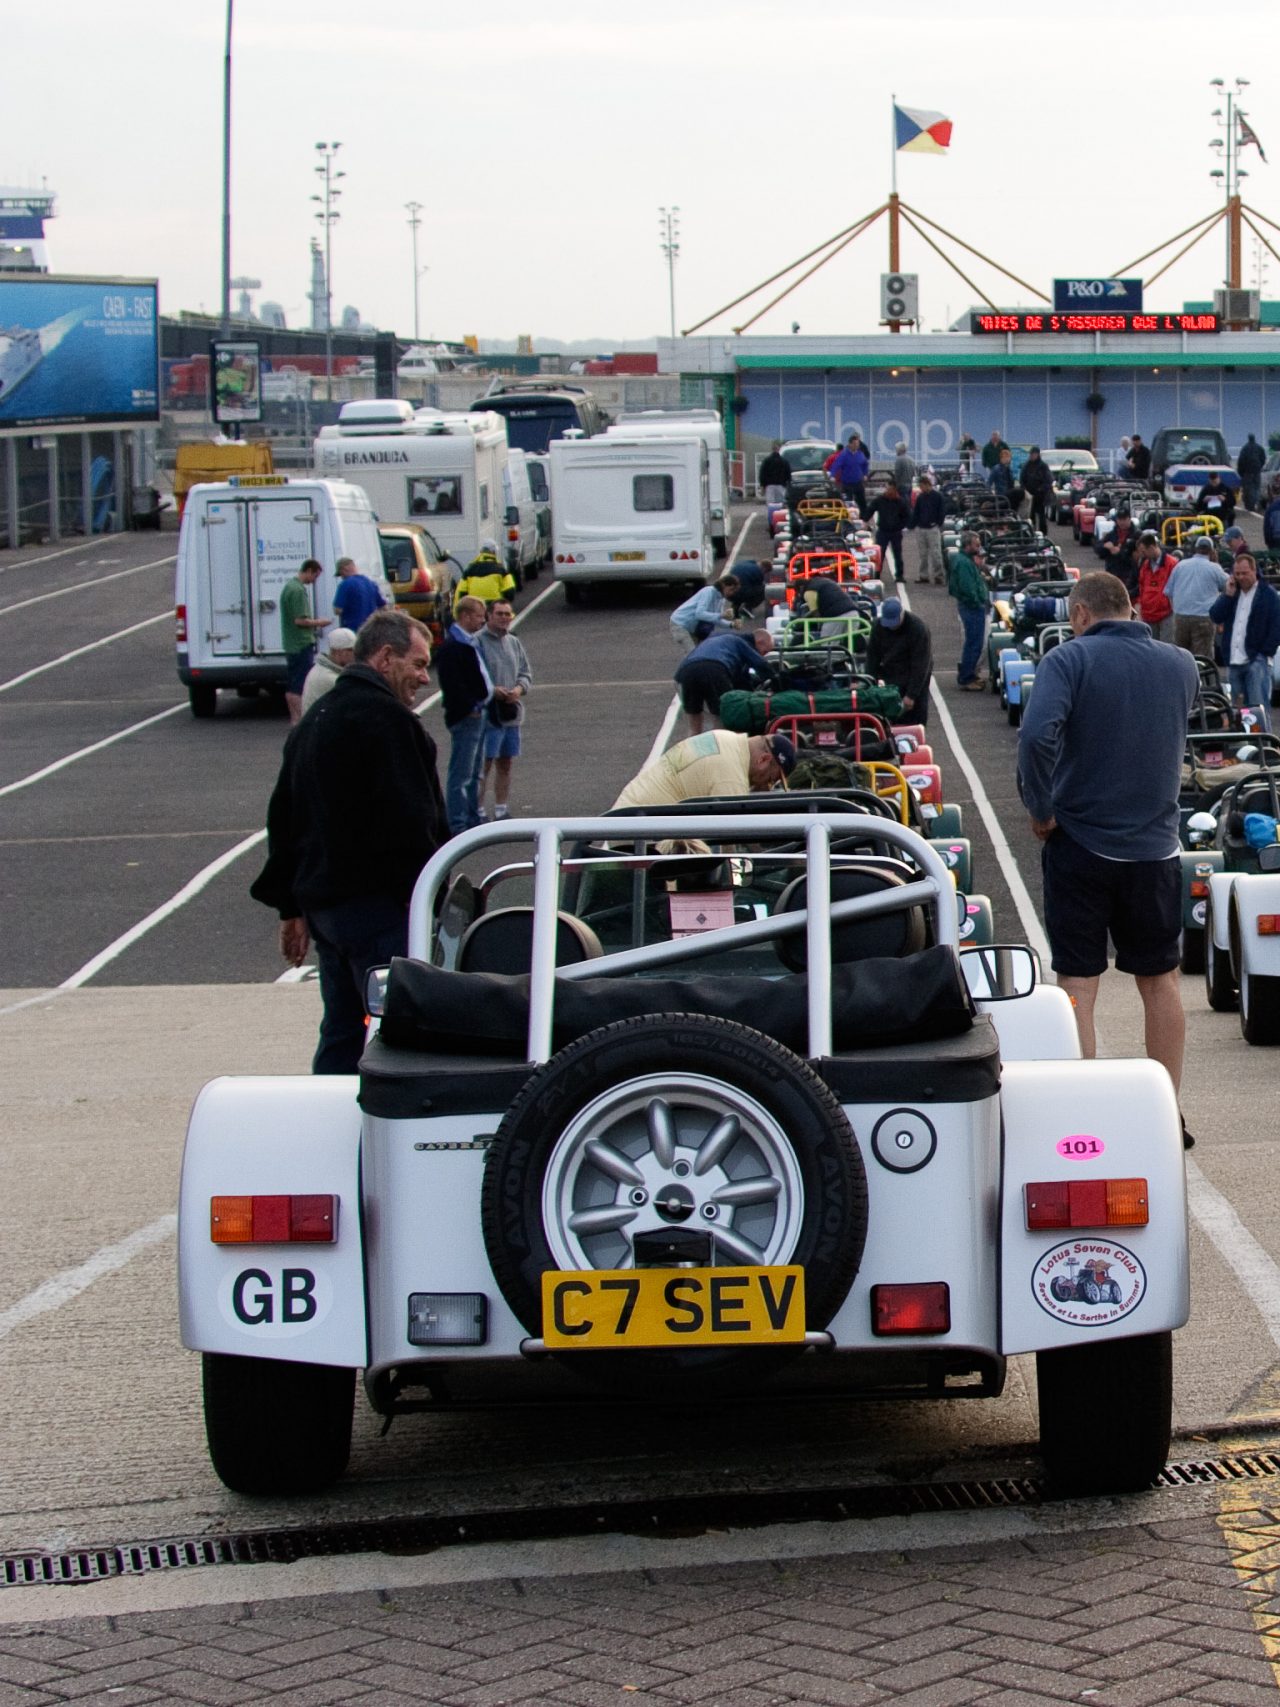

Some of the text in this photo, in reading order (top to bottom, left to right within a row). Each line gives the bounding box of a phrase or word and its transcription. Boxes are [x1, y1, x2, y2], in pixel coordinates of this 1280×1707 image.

[1067, 281, 1104, 297] P&O
[980, 315, 1018, 329] RIES
[801, 406, 953, 465] shop
[413, 1141, 495, 1151] CATERH
[1062, 1141, 1100, 1154] 101
[1041, 1243, 1137, 1275] Lotus Seven Club
[232, 1267, 318, 1326] GB
[553, 1275, 797, 1337] C7 SEV
[1119, 1279, 1140, 1312] Summer
